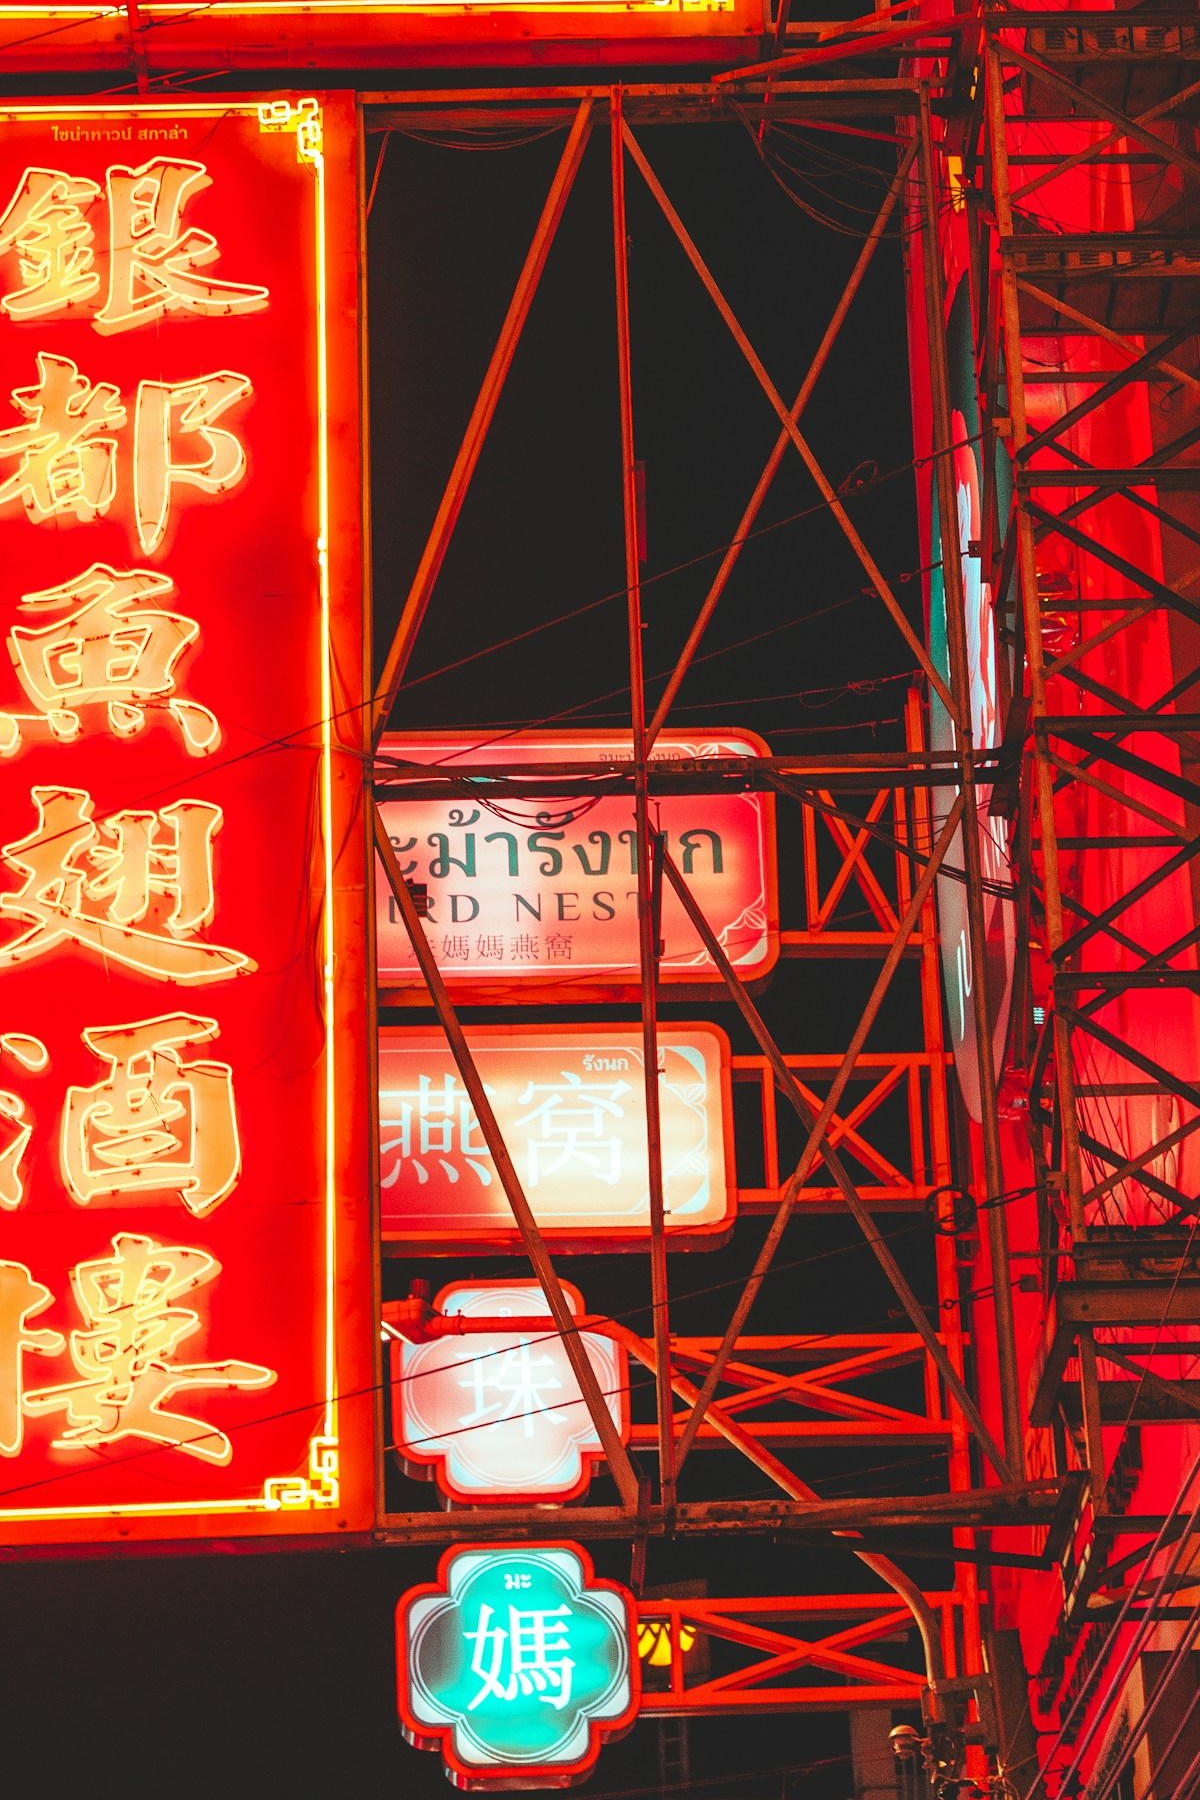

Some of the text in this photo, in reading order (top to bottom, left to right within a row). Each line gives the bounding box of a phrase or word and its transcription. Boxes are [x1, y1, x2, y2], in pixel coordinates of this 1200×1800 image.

[51, 124, 188, 141] ไชน่าทาวน์ สกาล่า
[582, 1054, 629, 1071] รังนก
[379, 1071, 632, 1189] 燕窩
[454, 1335, 569, 1439] 珠
[503, 1573, 532, 1591] มะ
[463, 1603, 577, 1712] 媽
